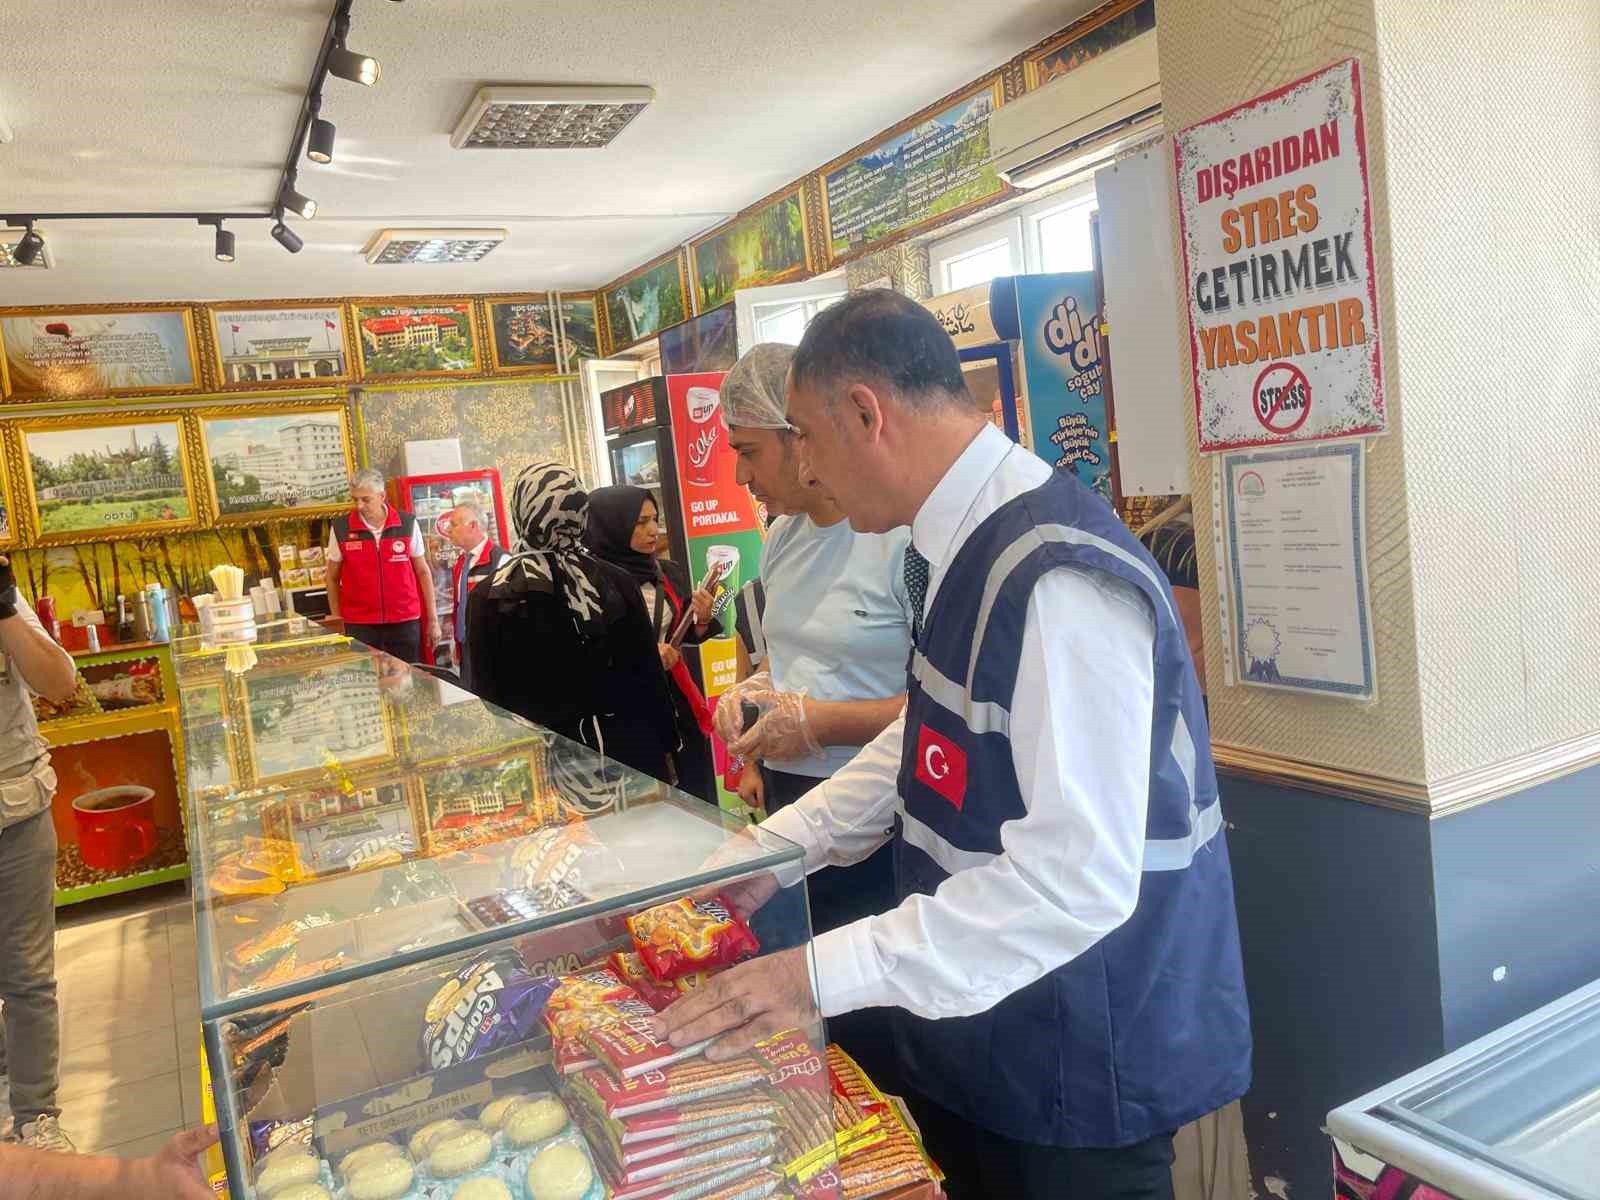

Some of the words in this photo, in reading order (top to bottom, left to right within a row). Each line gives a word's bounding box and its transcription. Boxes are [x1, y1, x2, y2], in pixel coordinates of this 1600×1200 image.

[1196, 118, 1340, 204] DIŞARIDAN
[1220, 184, 1319, 254] STRES
[1200, 297, 1367, 369] YASAKTIR
[1259, 383, 1305, 415] STRESS
[1059, 415, 1088, 427] Büyük
[690, 501, 705, 513] GO
[706, 499, 719, 510] UP
[692, 512, 740, 527] PORTAKAL
